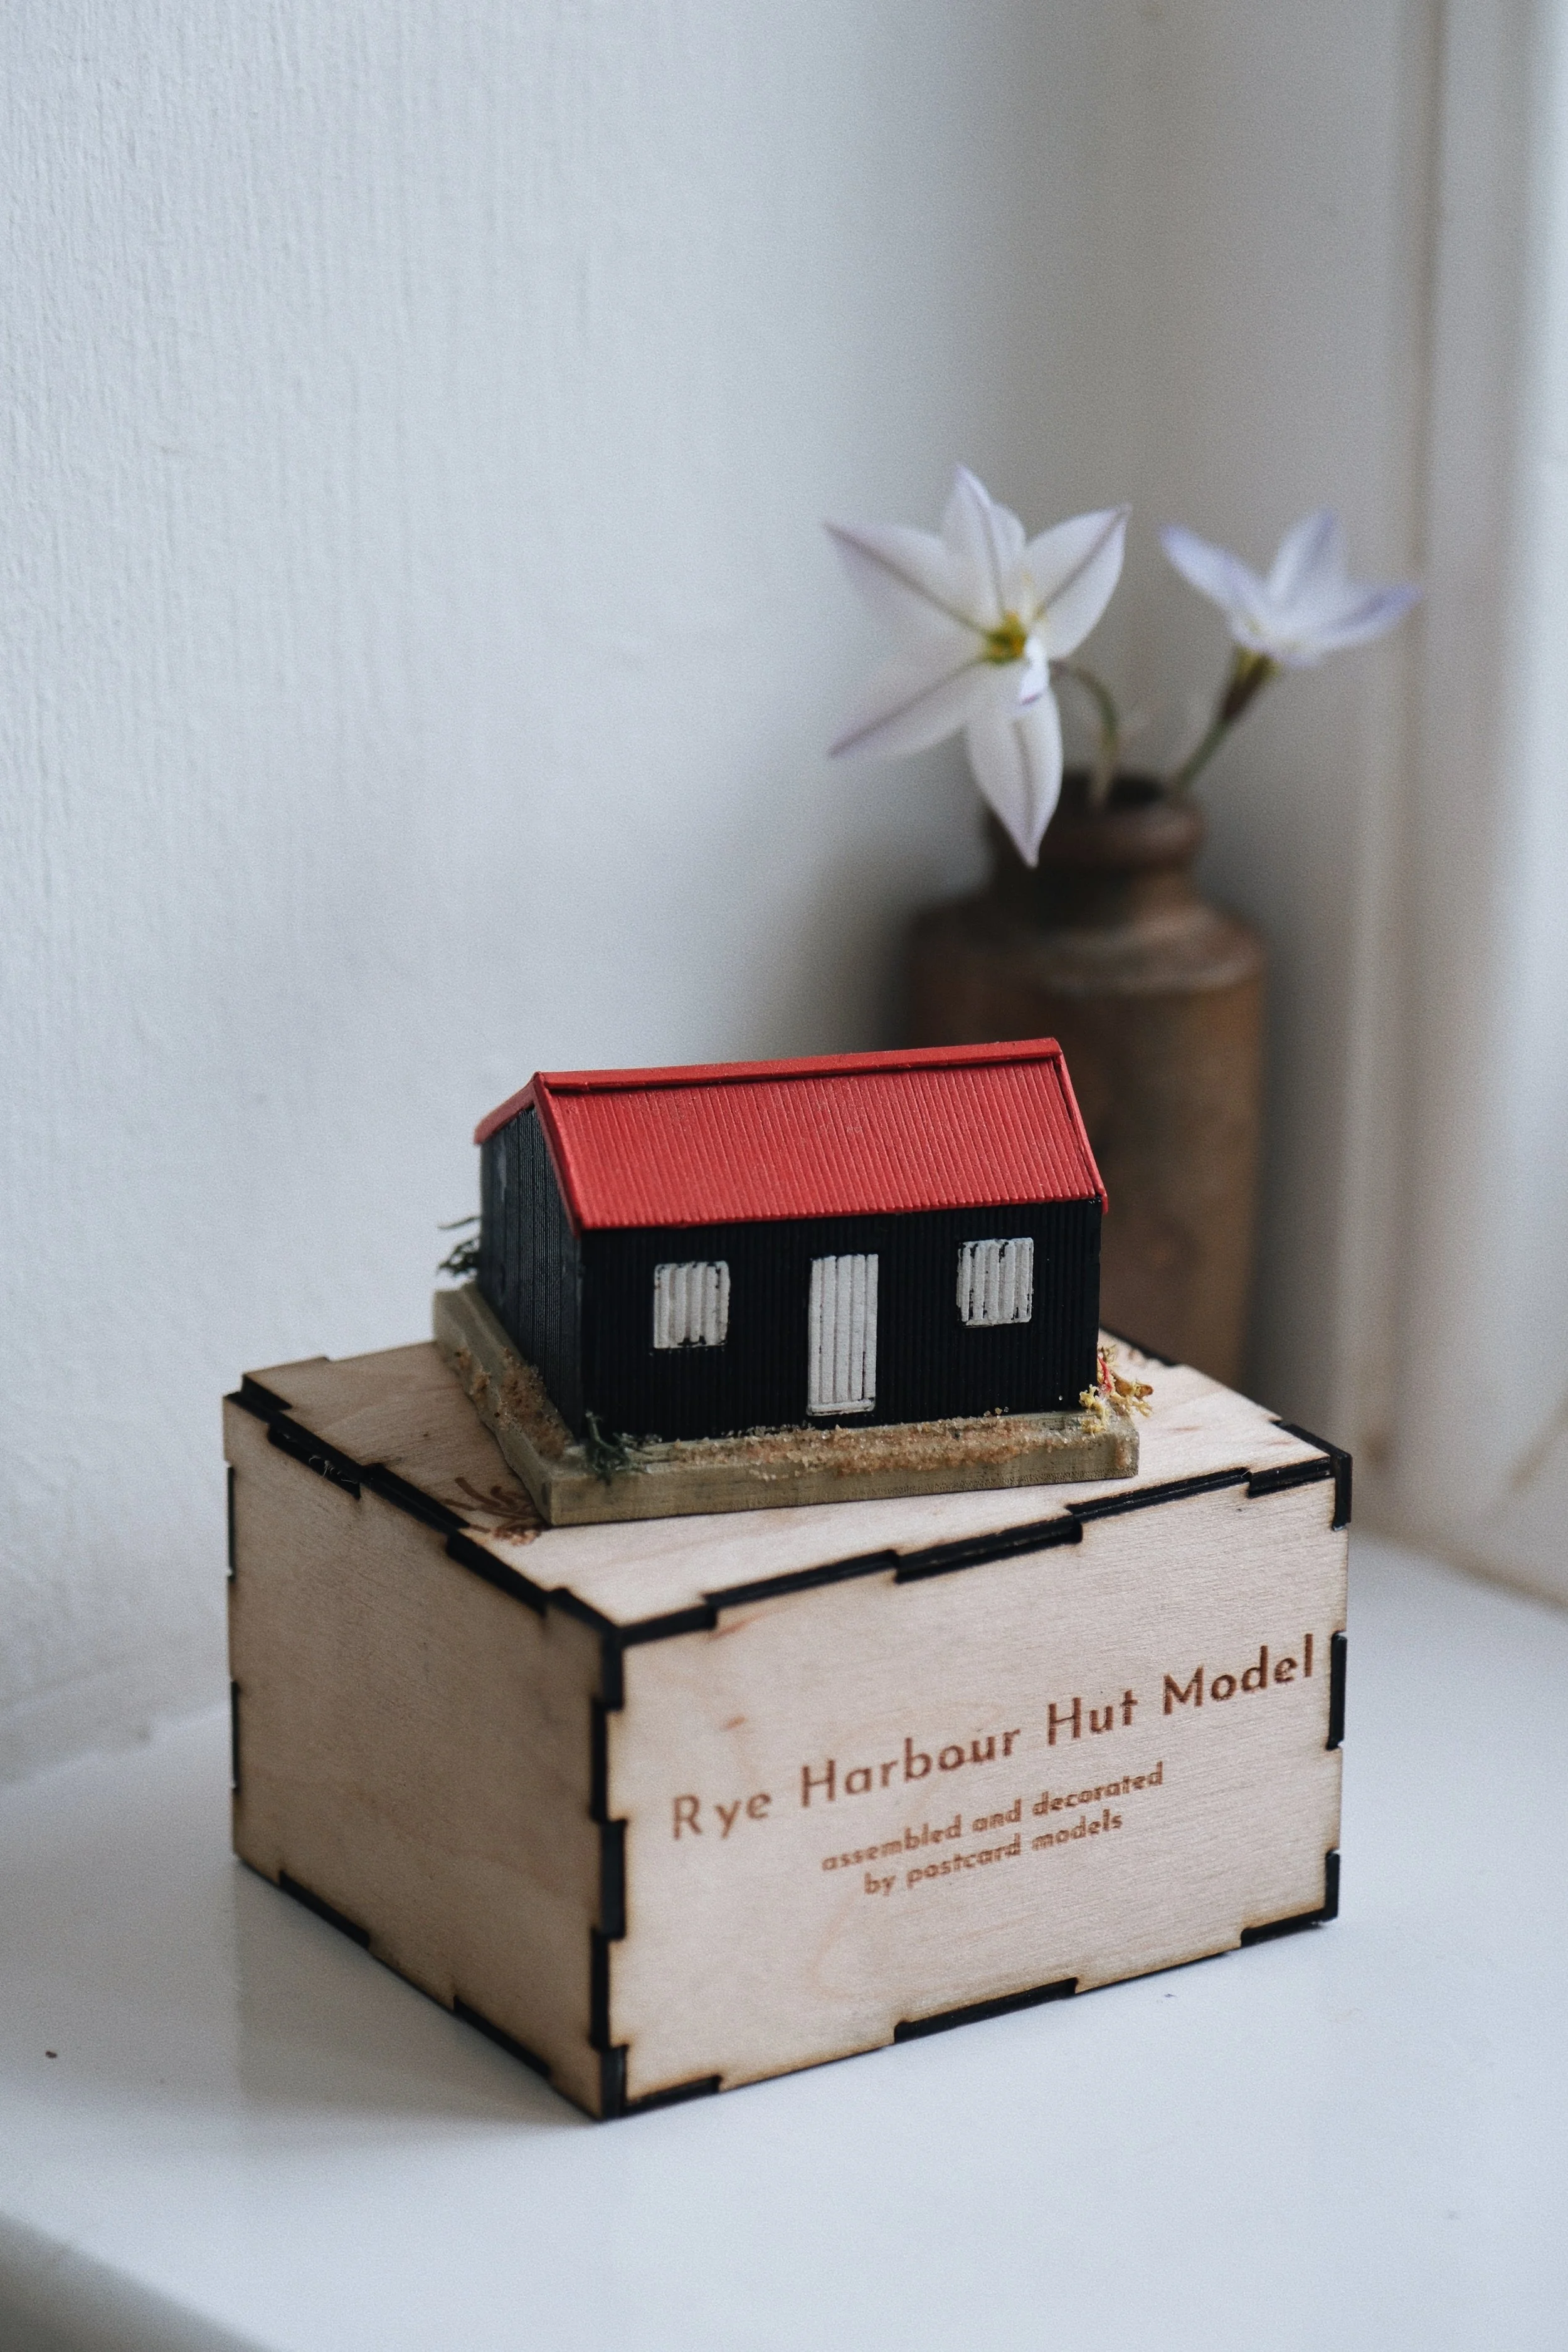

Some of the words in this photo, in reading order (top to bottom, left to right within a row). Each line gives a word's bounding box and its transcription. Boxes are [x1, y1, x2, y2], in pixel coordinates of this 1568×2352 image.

[672, 1791, 773, 1841] Rye
[800, 1728, 1022, 1809] Harbour
[1046, 1688, 1139, 1747] Hut
[1162, 1632, 1315, 1717] Model
[822, 1814, 962, 1872] assembled
[972, 1798, 1022, 1833] and
[1032, 1760, 1164, 1817] decorated
[864, 1872, 896, 1896] by
[906, 1833, 1022, 1889] postcard
[1032, 1808, 1124, 1851] models
